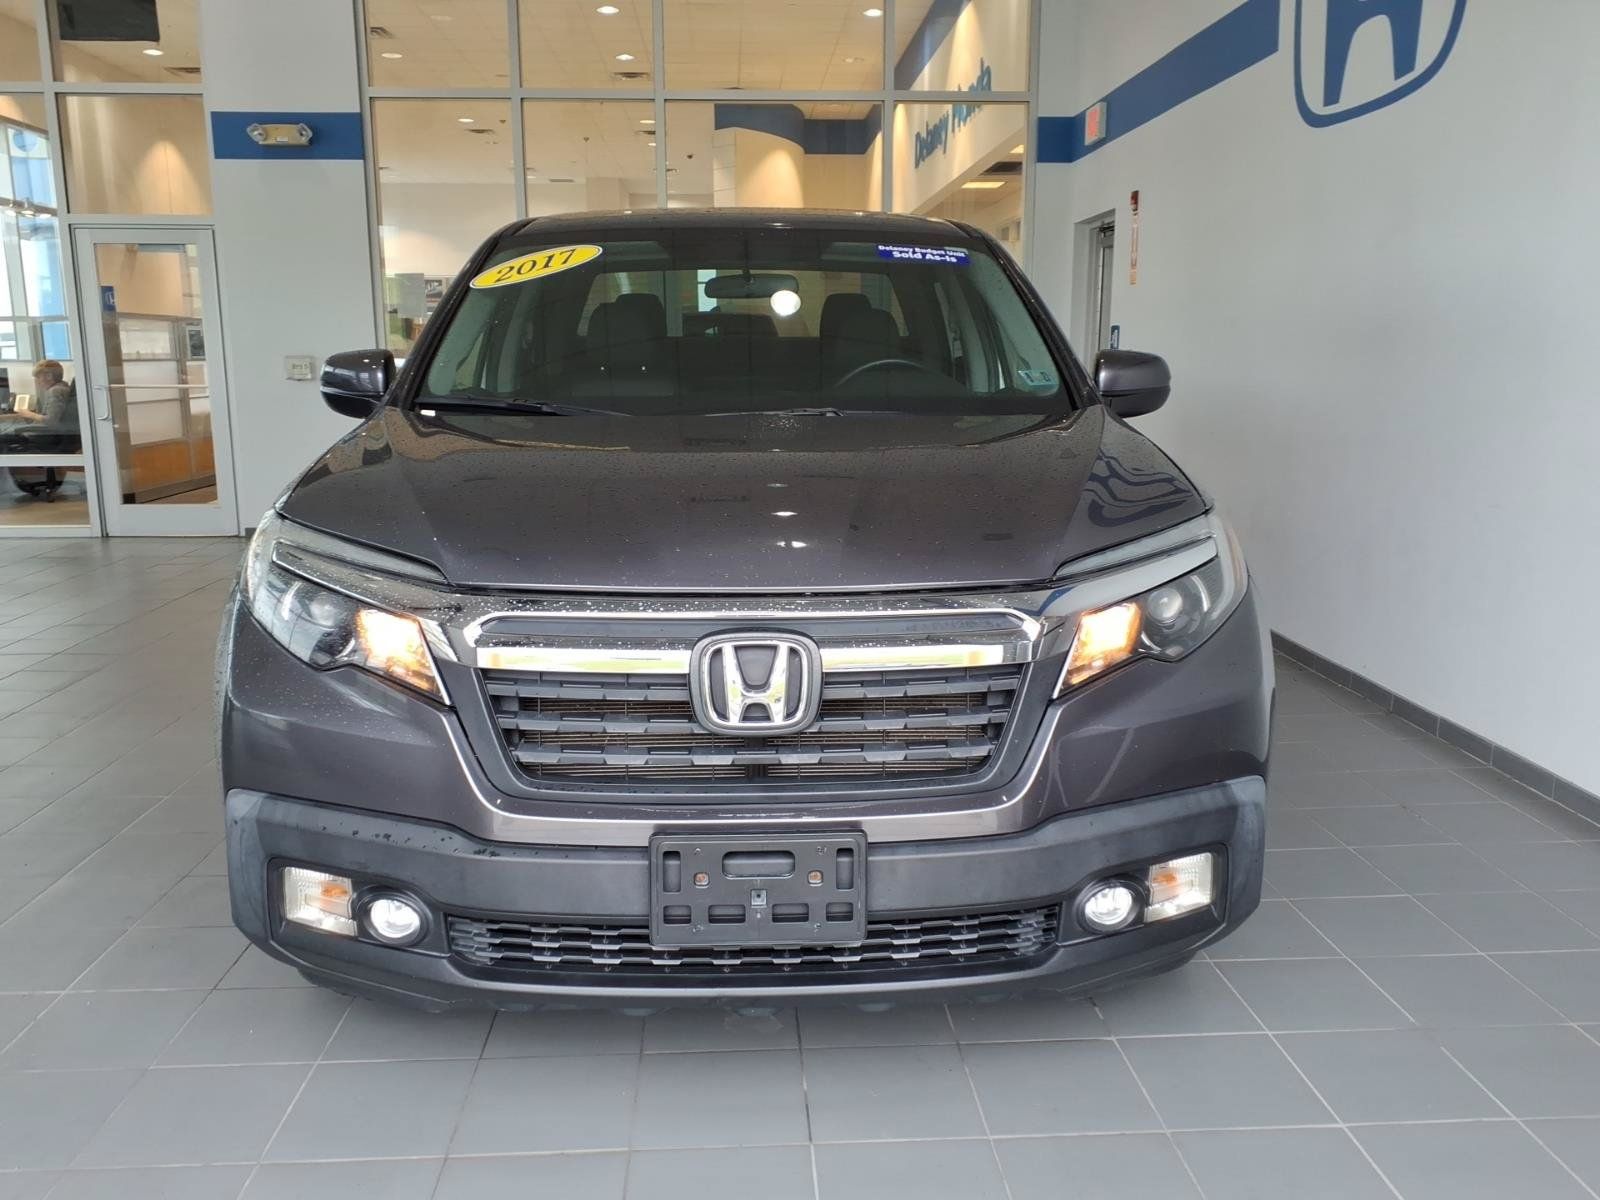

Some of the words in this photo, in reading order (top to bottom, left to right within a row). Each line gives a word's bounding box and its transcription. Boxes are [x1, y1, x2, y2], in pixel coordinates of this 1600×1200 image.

[878, 245, 913, 253] Delaney
[892, 251, 923, 259] Sold
[925, 253, 958, 262] As-Is
[494, 248, 576, 283] 2017
